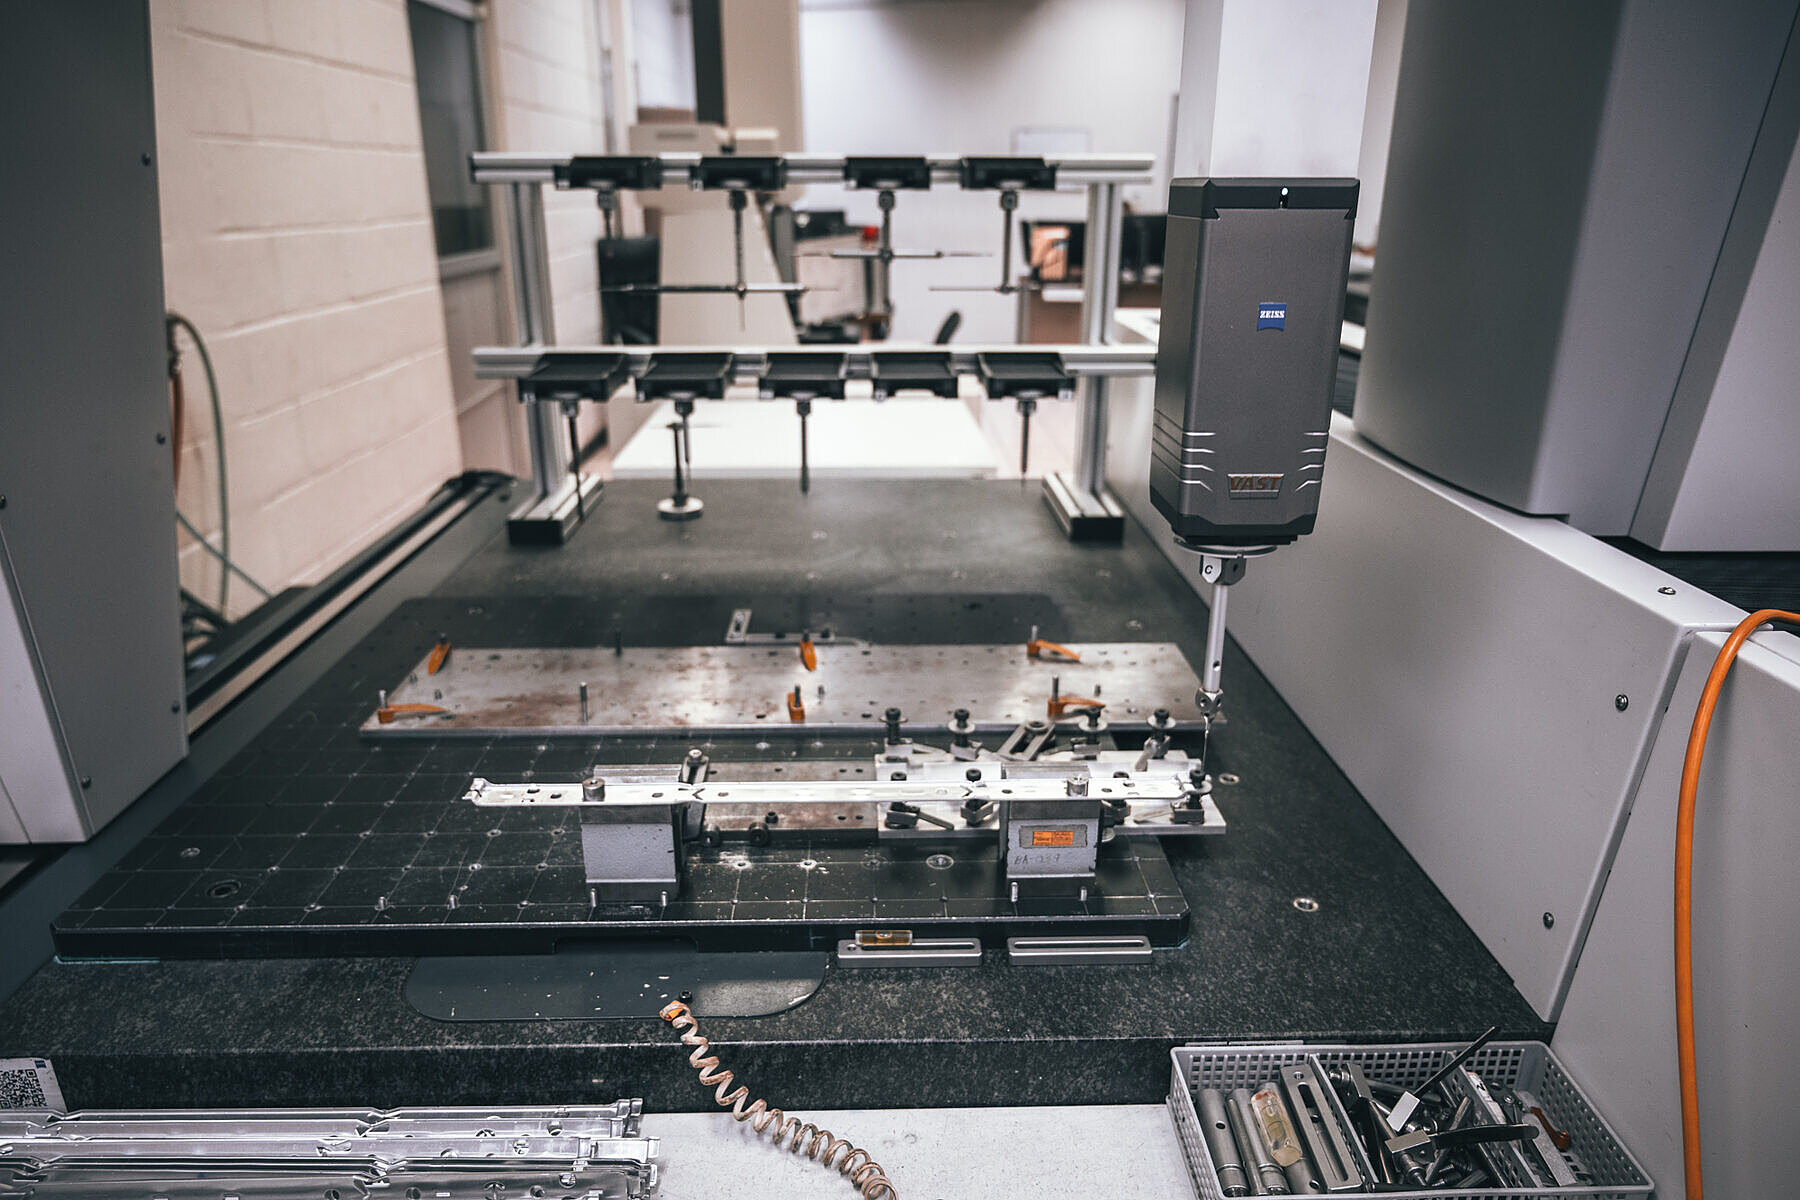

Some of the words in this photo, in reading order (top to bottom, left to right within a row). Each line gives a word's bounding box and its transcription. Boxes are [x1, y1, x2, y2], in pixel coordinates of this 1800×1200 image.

[1259, 310, 1285, 319] ZEISS
[1229, 475, 1282, 491] VAST
[1204, 564, 1213, 575] C
